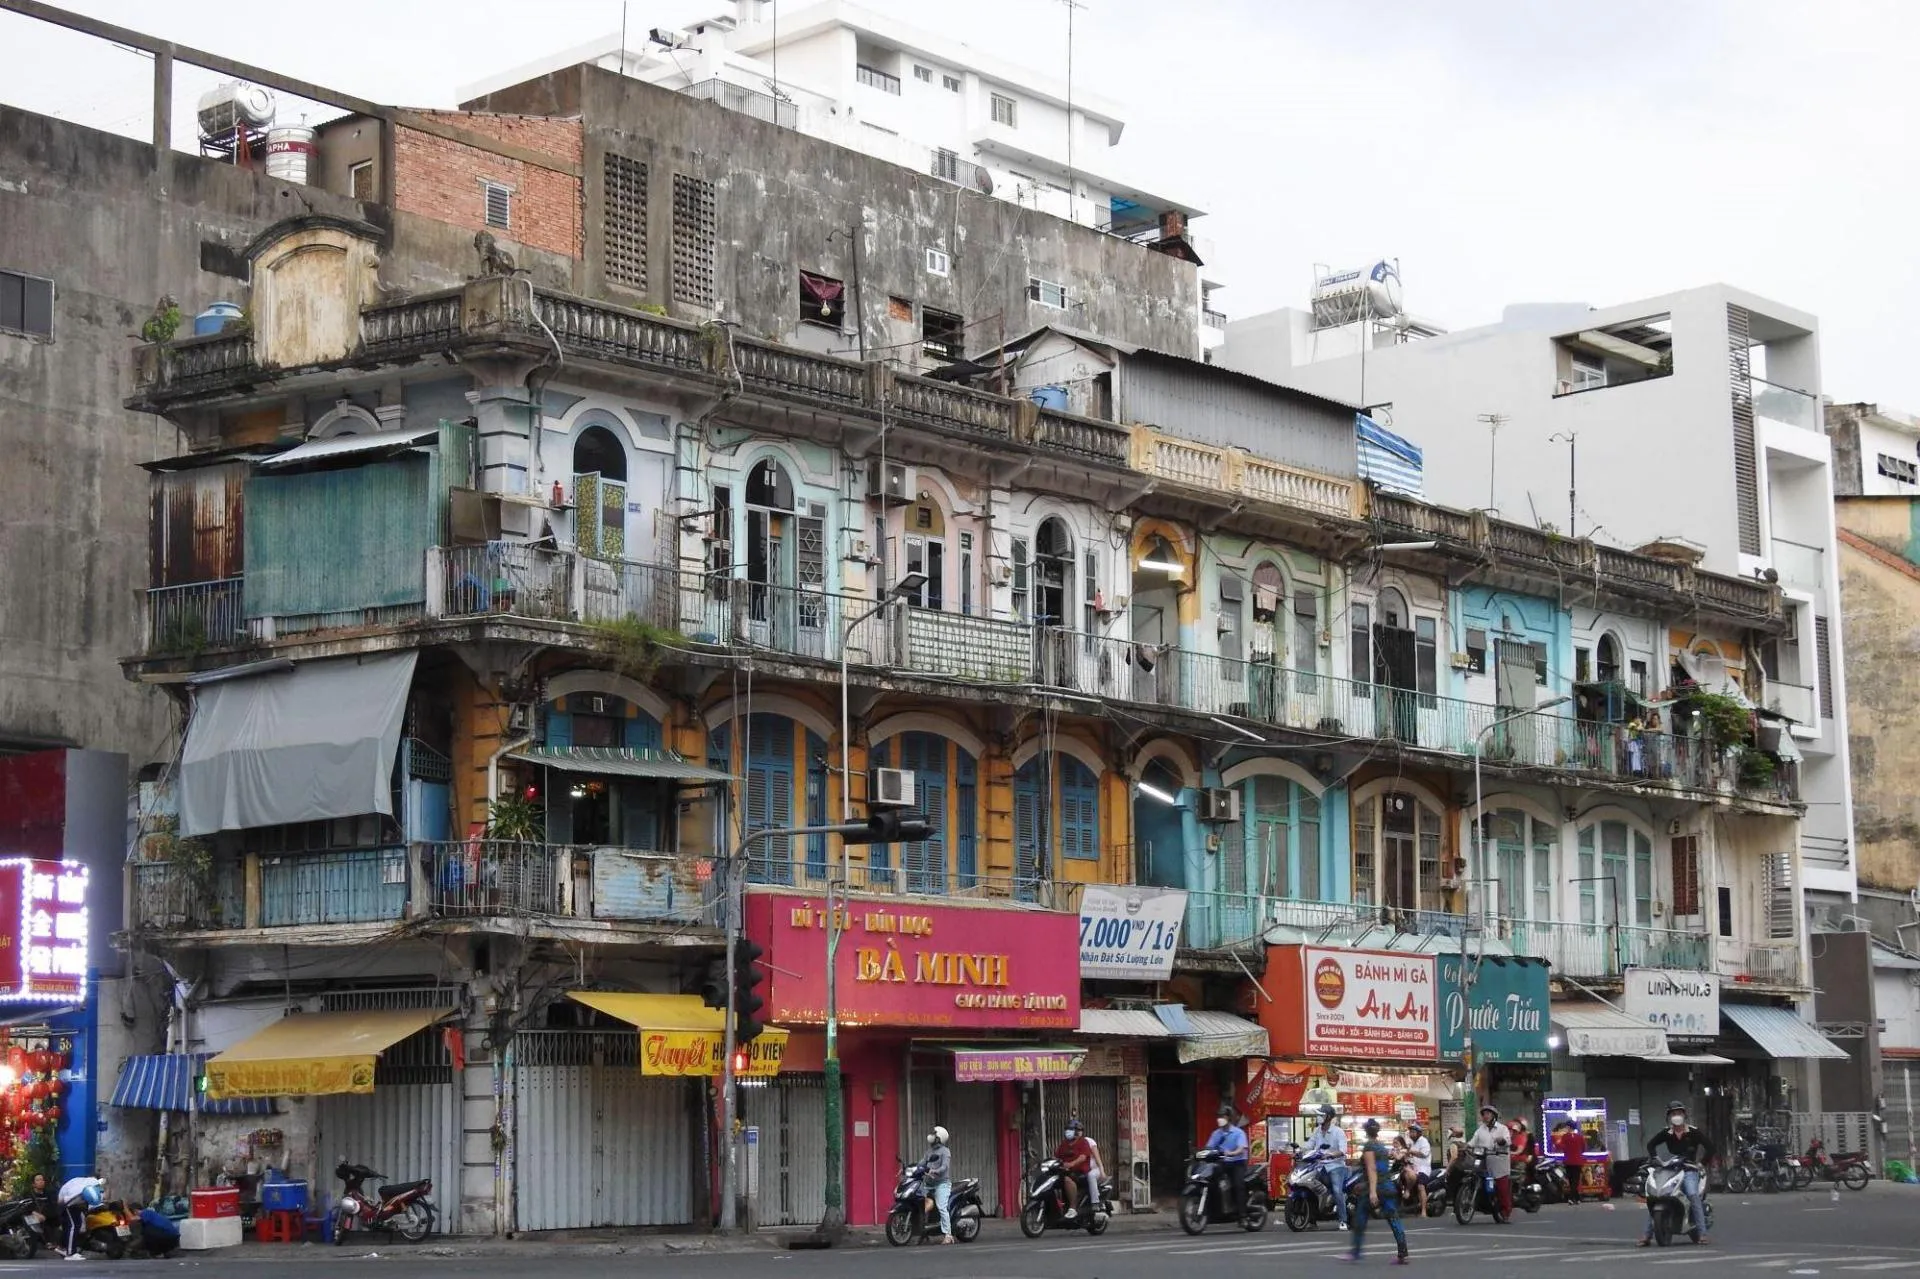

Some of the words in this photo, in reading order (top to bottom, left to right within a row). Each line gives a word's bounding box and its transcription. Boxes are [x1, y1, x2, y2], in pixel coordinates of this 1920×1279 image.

[856, 937, 906, 982] BÀ
[915, 951, 1009, 986] MINH
[1355, 960, 1390, 982] BÁNH
[1393, 963, 1408, 983] MÌ
[1411, 965, 1428, 984] GÀ
[1648, 981, 1671, 996] LINH
[1356, 988, 1391, 1020] An
[1395, 991, 1429, 1022] An
